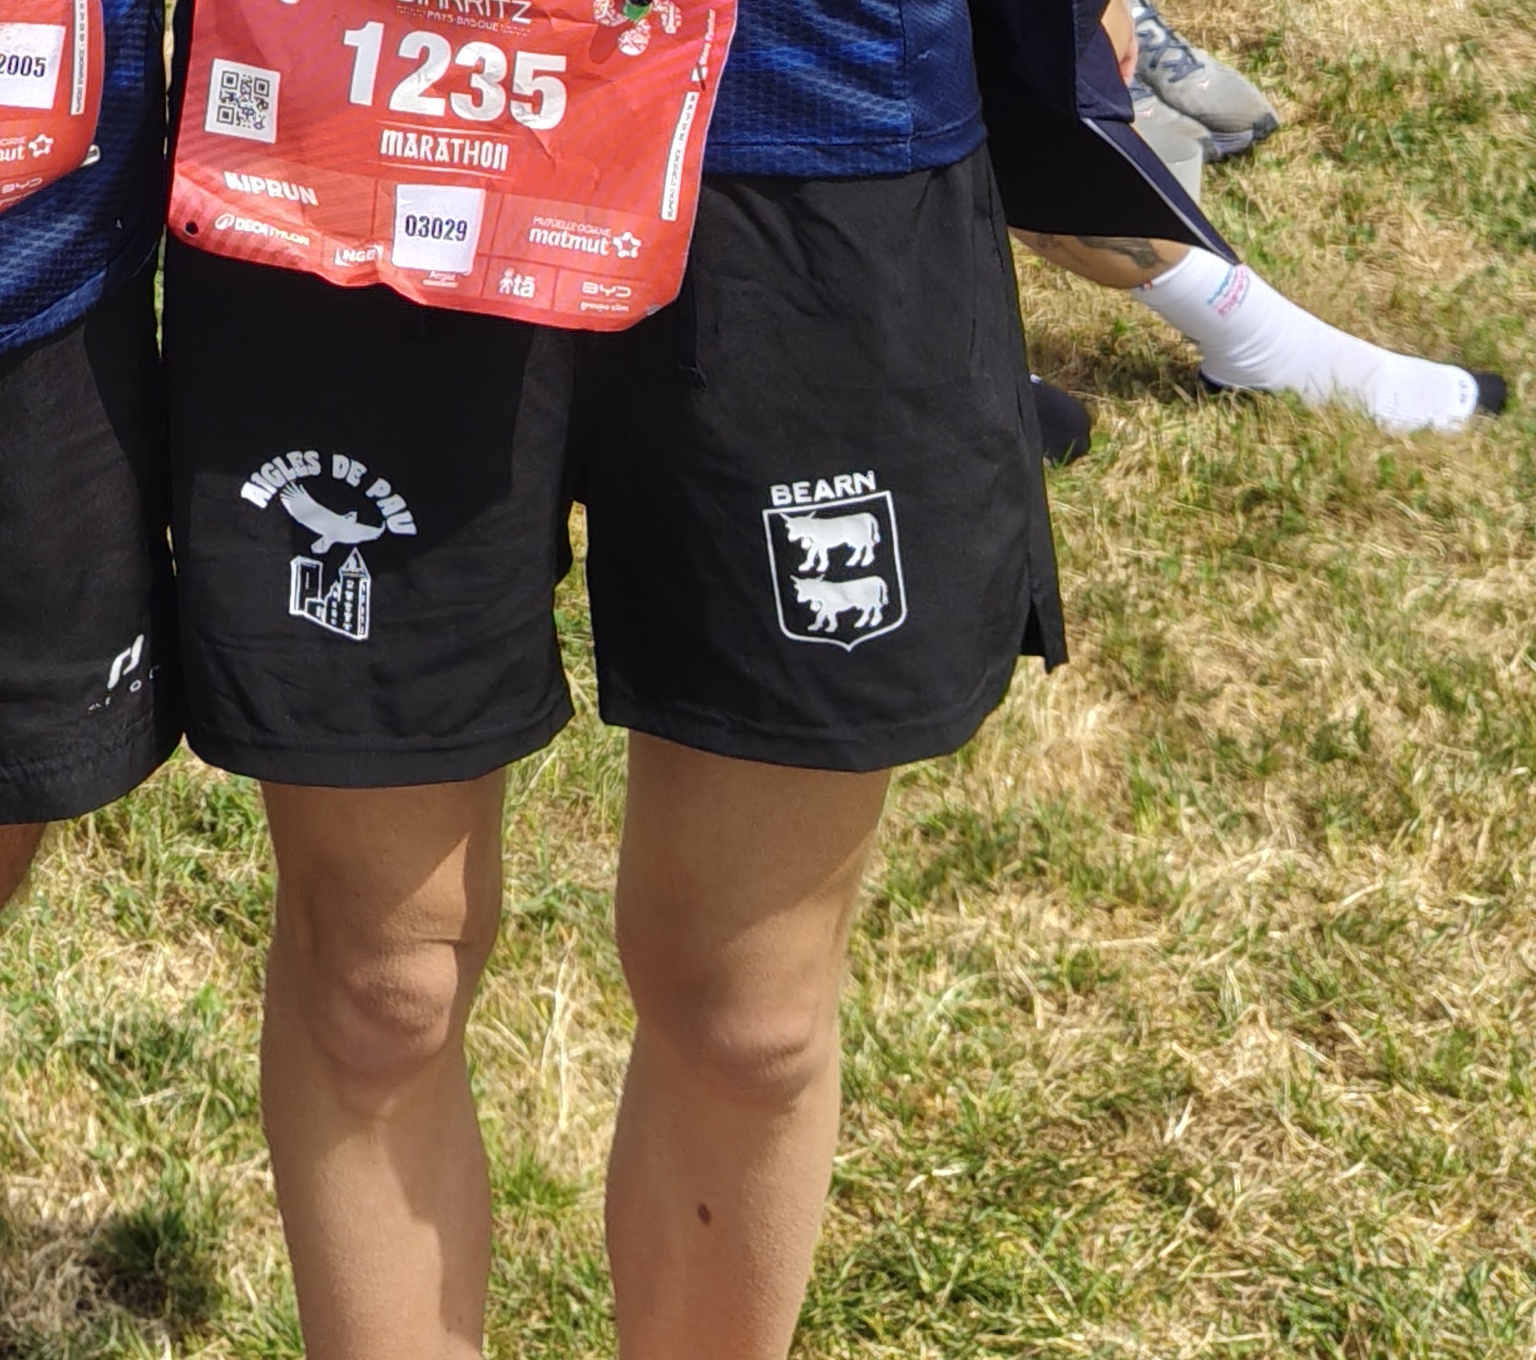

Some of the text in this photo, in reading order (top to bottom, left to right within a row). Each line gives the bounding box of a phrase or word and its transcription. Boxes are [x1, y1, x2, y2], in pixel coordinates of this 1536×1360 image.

[427, 11, 499, 32] PAYS BASQUE
[344, 21, 567, 130] 1235
[380, 129, 509, 171] MARATHON
[1, 177, 42, 194] BYD
[223, 171, 319, 206] KIPRUN
[405, 214, 468, 241] 03029
[529, 227, 610, 255] matmut
[582, 281, 632, 298] BYD
[240, 450, 418, 536] AIGLES DE PAU
[770, 470, 876, 506] BEARN
